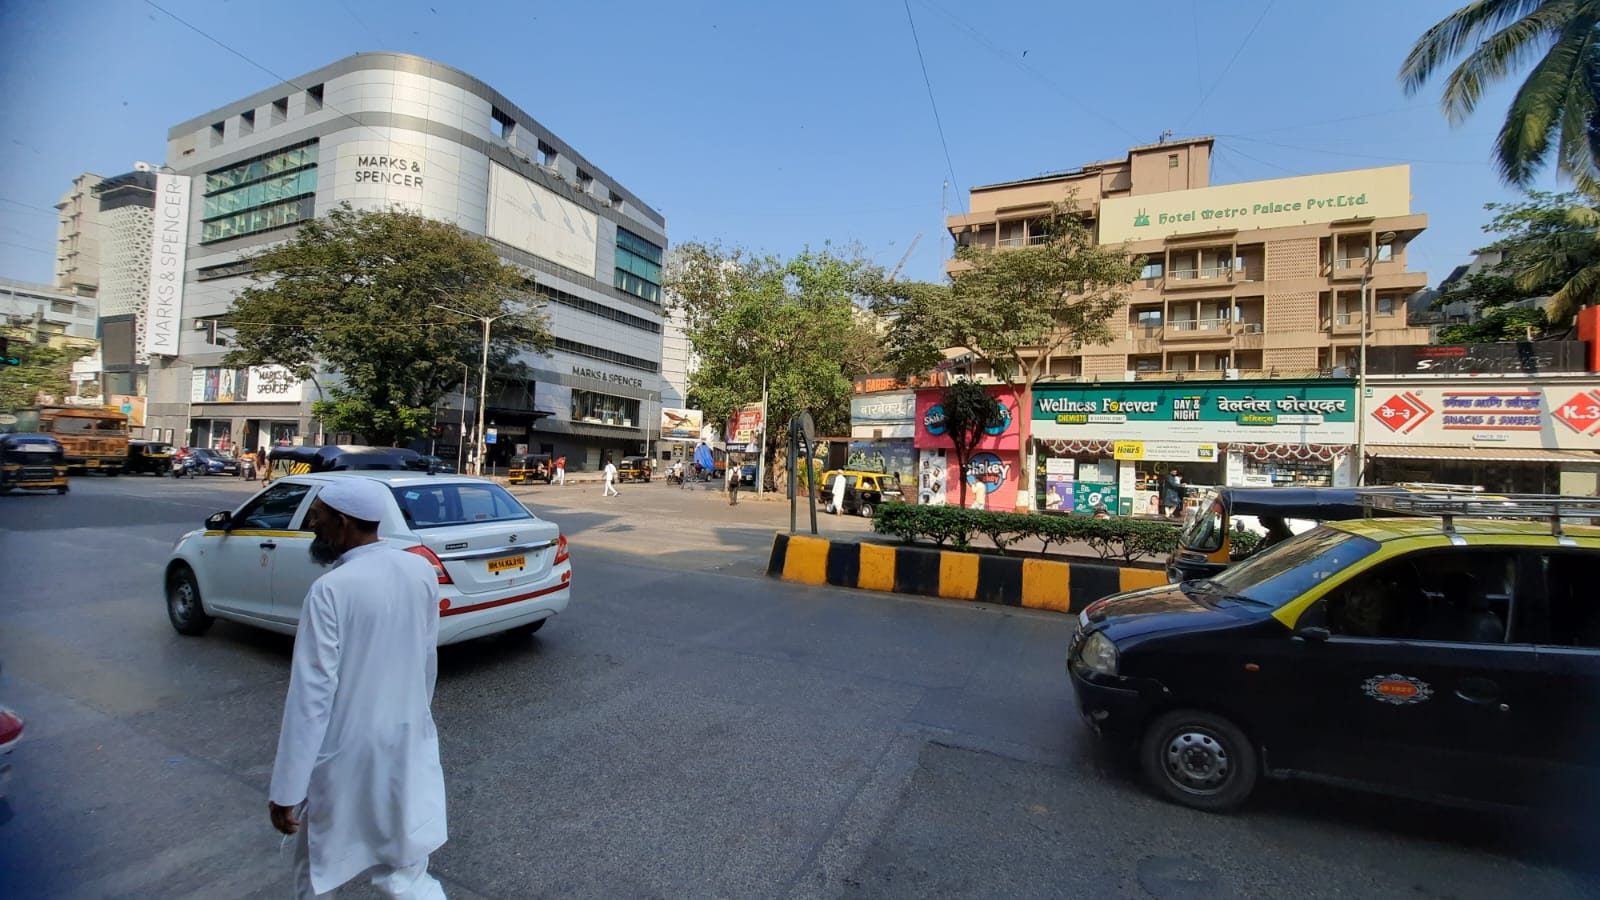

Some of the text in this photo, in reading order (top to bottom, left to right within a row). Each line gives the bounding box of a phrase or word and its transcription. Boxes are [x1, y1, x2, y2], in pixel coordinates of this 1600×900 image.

[358, 156, 420, 172] MARKS &
[355, 170, 423, 188] SPENCER
[1159, 210, 1196, 224] Hotel
[1201, 207, 1248, 221] Metro
[1253, 202, 1302, 215] Palace
[572, 366, 601, 379] MARKS
[608, 373, 642, 388] SPENCER
[257, 384, 288, 394] SPENCER
[1039, 398, 1158, 413] Wellness Forever
[1173, 400, 1200, 410] DAY &
[1217, 396, 1347, 414] वेलनेस फोरएव्हर
[1173, 410, 1200, 420] NIGHT
[1442, 416, 1483, 425] SNACKS
[1499, 416, 1541, 425] SWEETS
